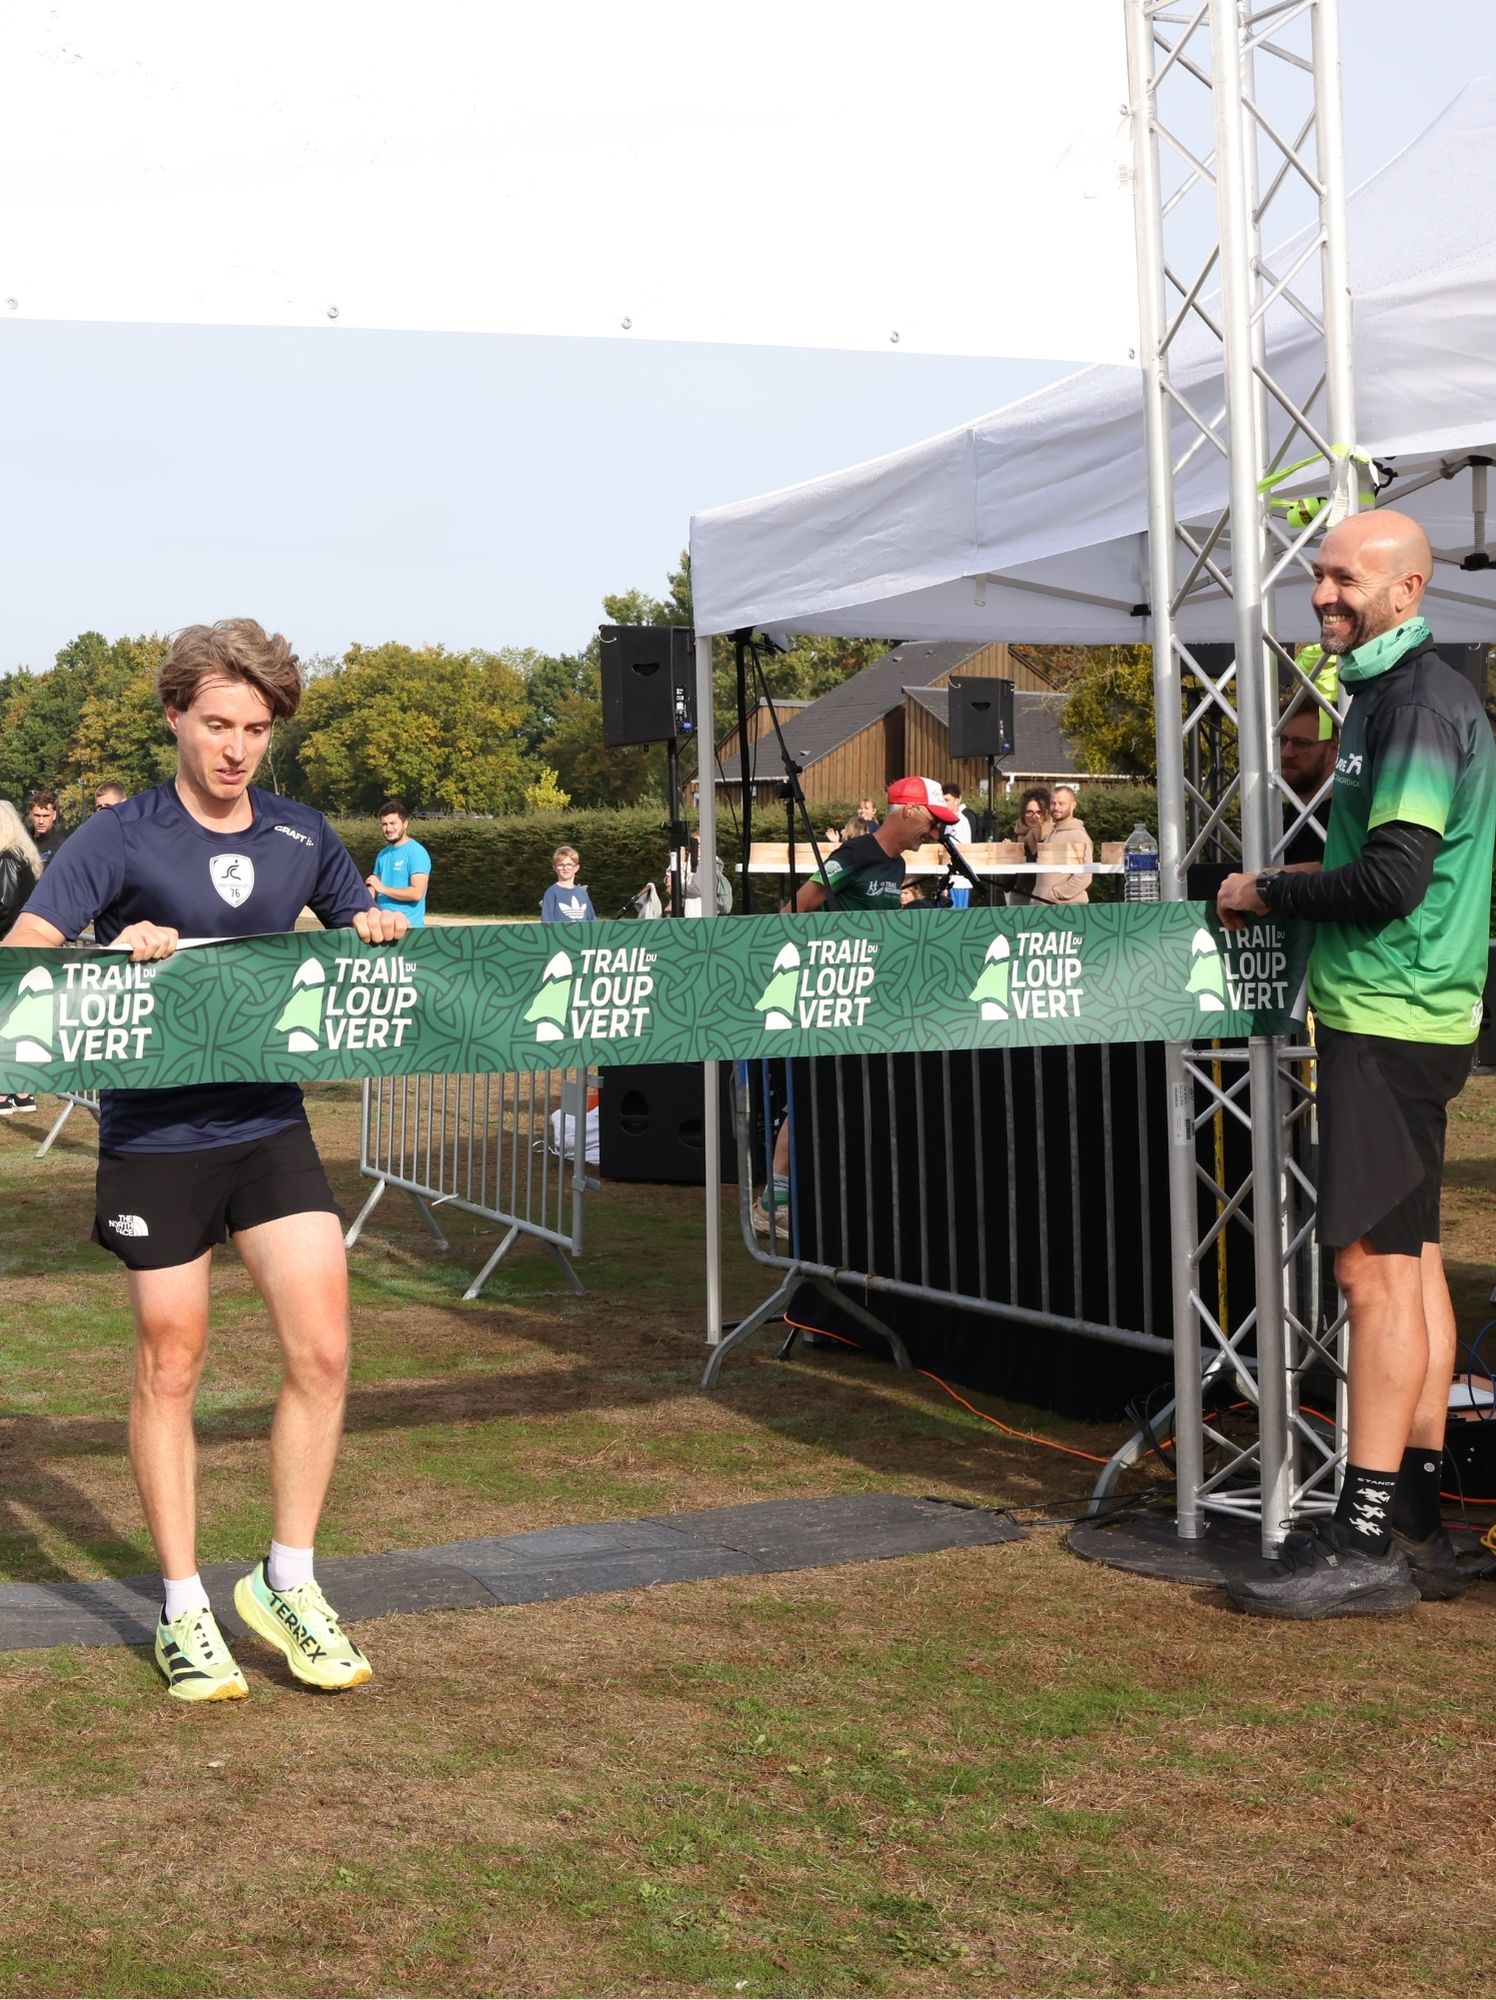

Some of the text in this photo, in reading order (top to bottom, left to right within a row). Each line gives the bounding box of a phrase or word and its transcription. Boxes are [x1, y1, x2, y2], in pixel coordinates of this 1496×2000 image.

[274, 825, 307, 842] CRAFT
[230, 888, 240, 898] 76
[807, 939, 878, 964] TRAIL DU
[1017, 931, 1082, 956] TRAIL DU
[1219, 925, 1285, 949] TRAIL DU
[335, 957, 417, 984] TRAIL DU
[581, 947, 657, 974] TRAIL DU
[1011, 958, 1082, 988] LOUP
[1223, 951, 1287, 980] LOUP
[62, 962, 156, 990] TRAIL DU
[801, 967, 874, 997] LOUP
[325, 986, 417, 1016] LOUP
[573, 976, 654, 1007] LOUP
[1012, 988, 1084, 1019] VERT
[1226, 981, 1288, 1011] VERT
[59, 993, 155, 1027] LOUP
[571, 1008, 650, 1039] VERT
[799, 997, 871, 1028] VERT
[58, 1028, 152, 1062] VERT
[325, 1018, 412, 1050] VERT
[108, 1219, 134, 1230] NORTH
[118, 1214, 133, 1222] THE
[1357, 1477, 1395, 1486] STANCE
[269, 1592, 327, 1664] TERREX
